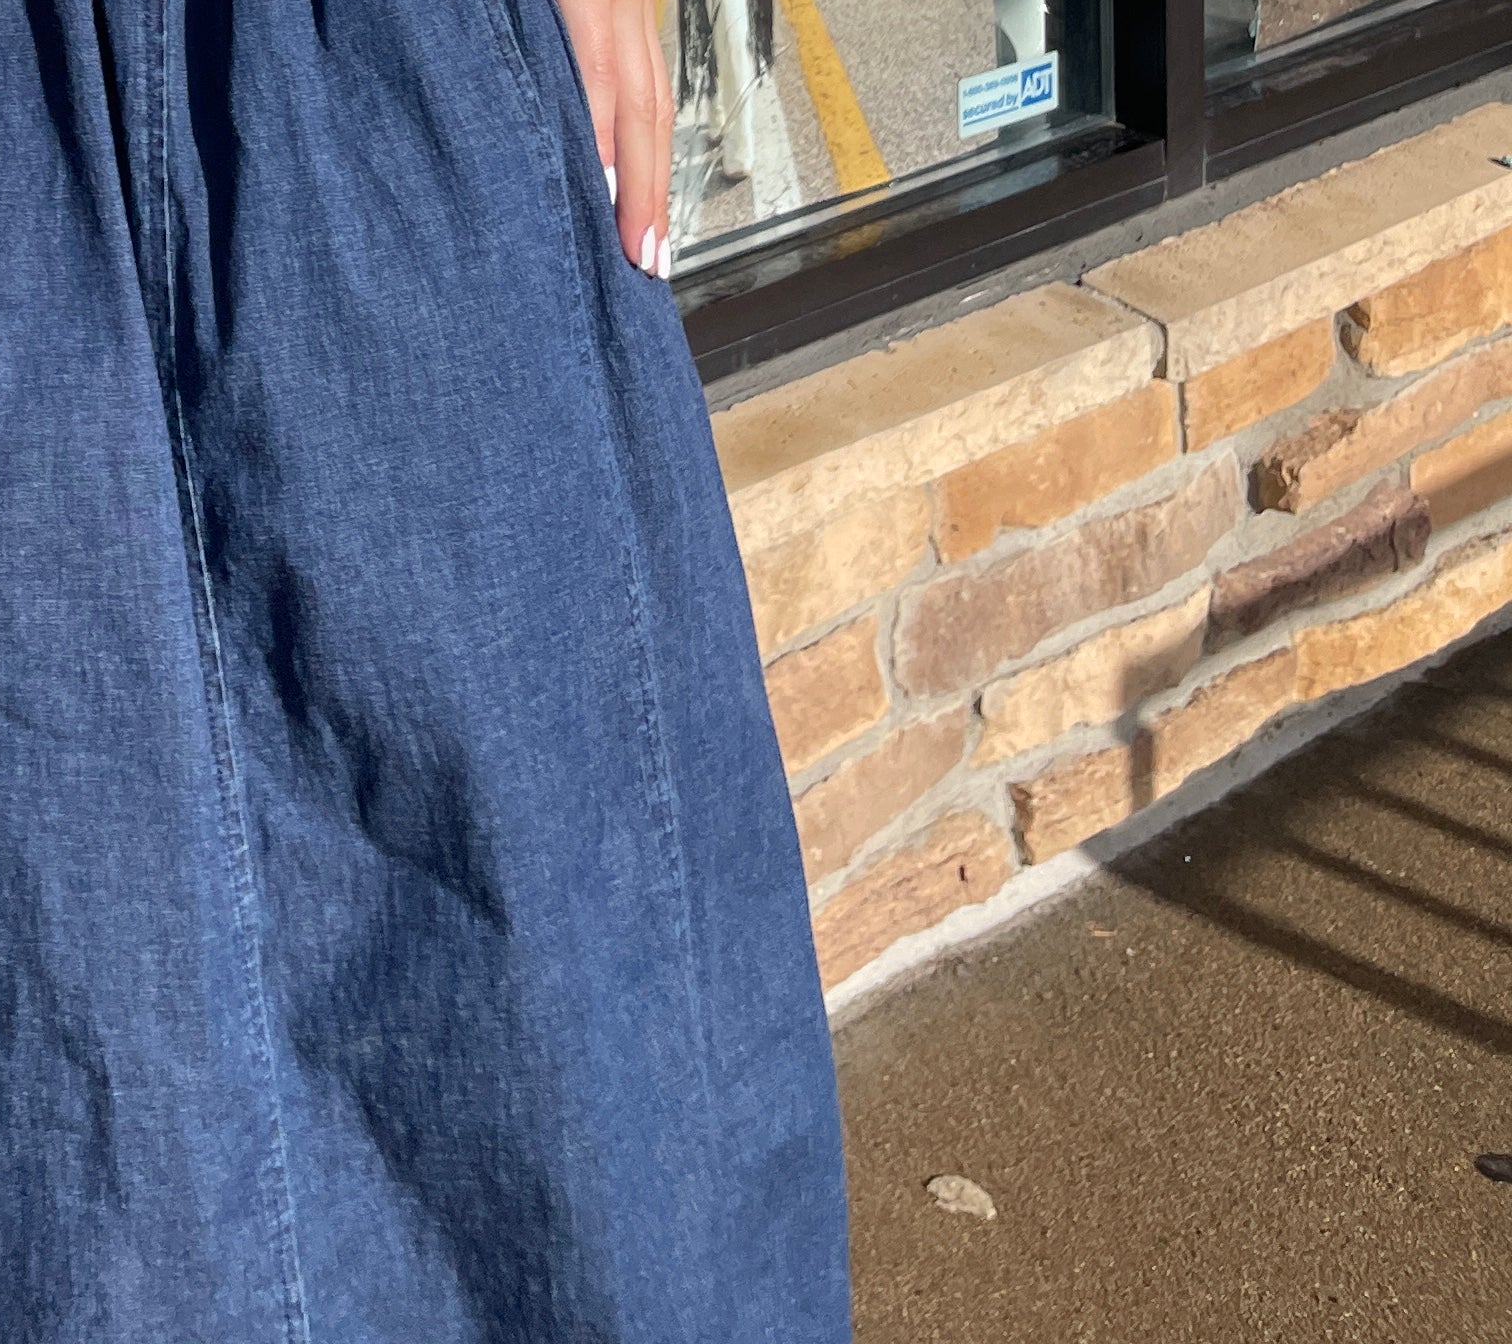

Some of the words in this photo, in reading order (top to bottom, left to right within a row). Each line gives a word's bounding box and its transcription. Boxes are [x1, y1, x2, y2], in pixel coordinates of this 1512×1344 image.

[1022, 70, 1052, 102] ADT
[962, 94, 1005, 120] secured
[1006, 92, 1019, 108] by
